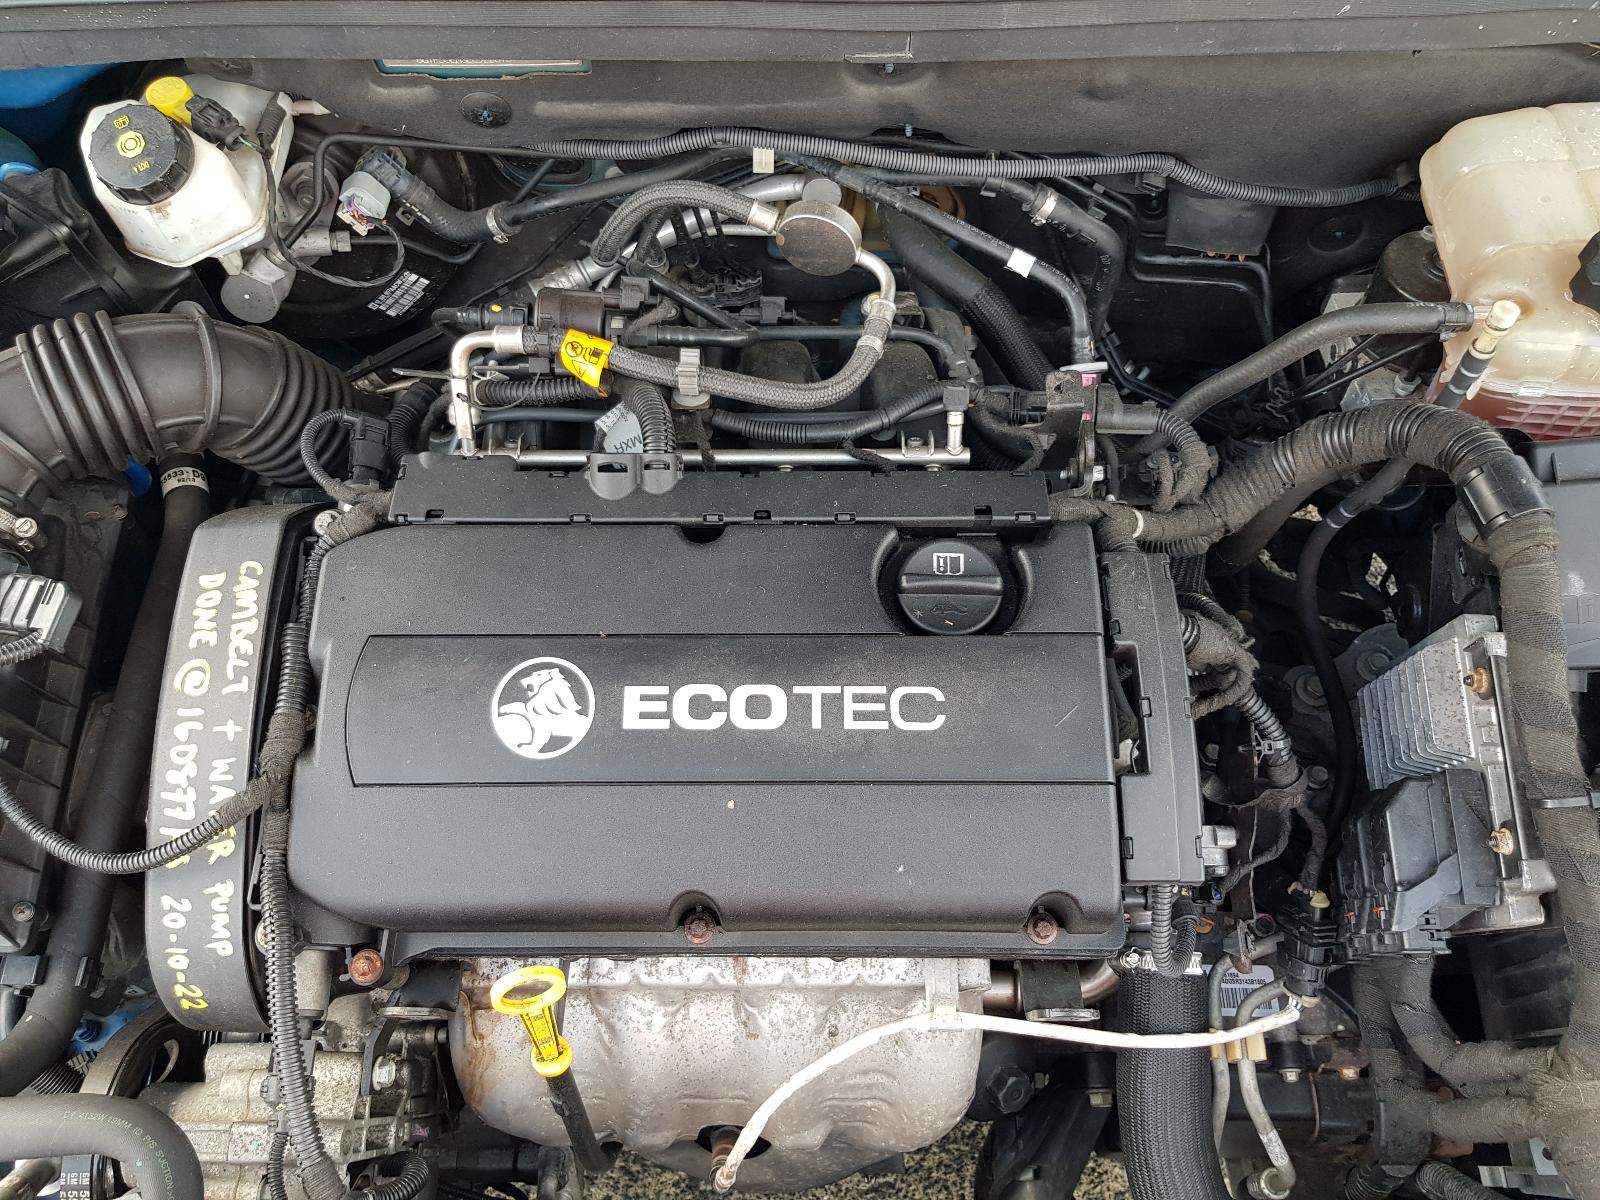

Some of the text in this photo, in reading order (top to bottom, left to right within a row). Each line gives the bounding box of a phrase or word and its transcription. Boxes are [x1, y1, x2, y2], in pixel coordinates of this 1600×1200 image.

[188, 572, 227, 649] DONE
[221, 560, 264, 695] CAMBELT
[622, 683, 947, 730] ECOTEC
[160, 895, 208, 1009] 20-10-22
[203, 879, 235, 957] PUMP
[156, 1150, 174, 1190] SUCTION
